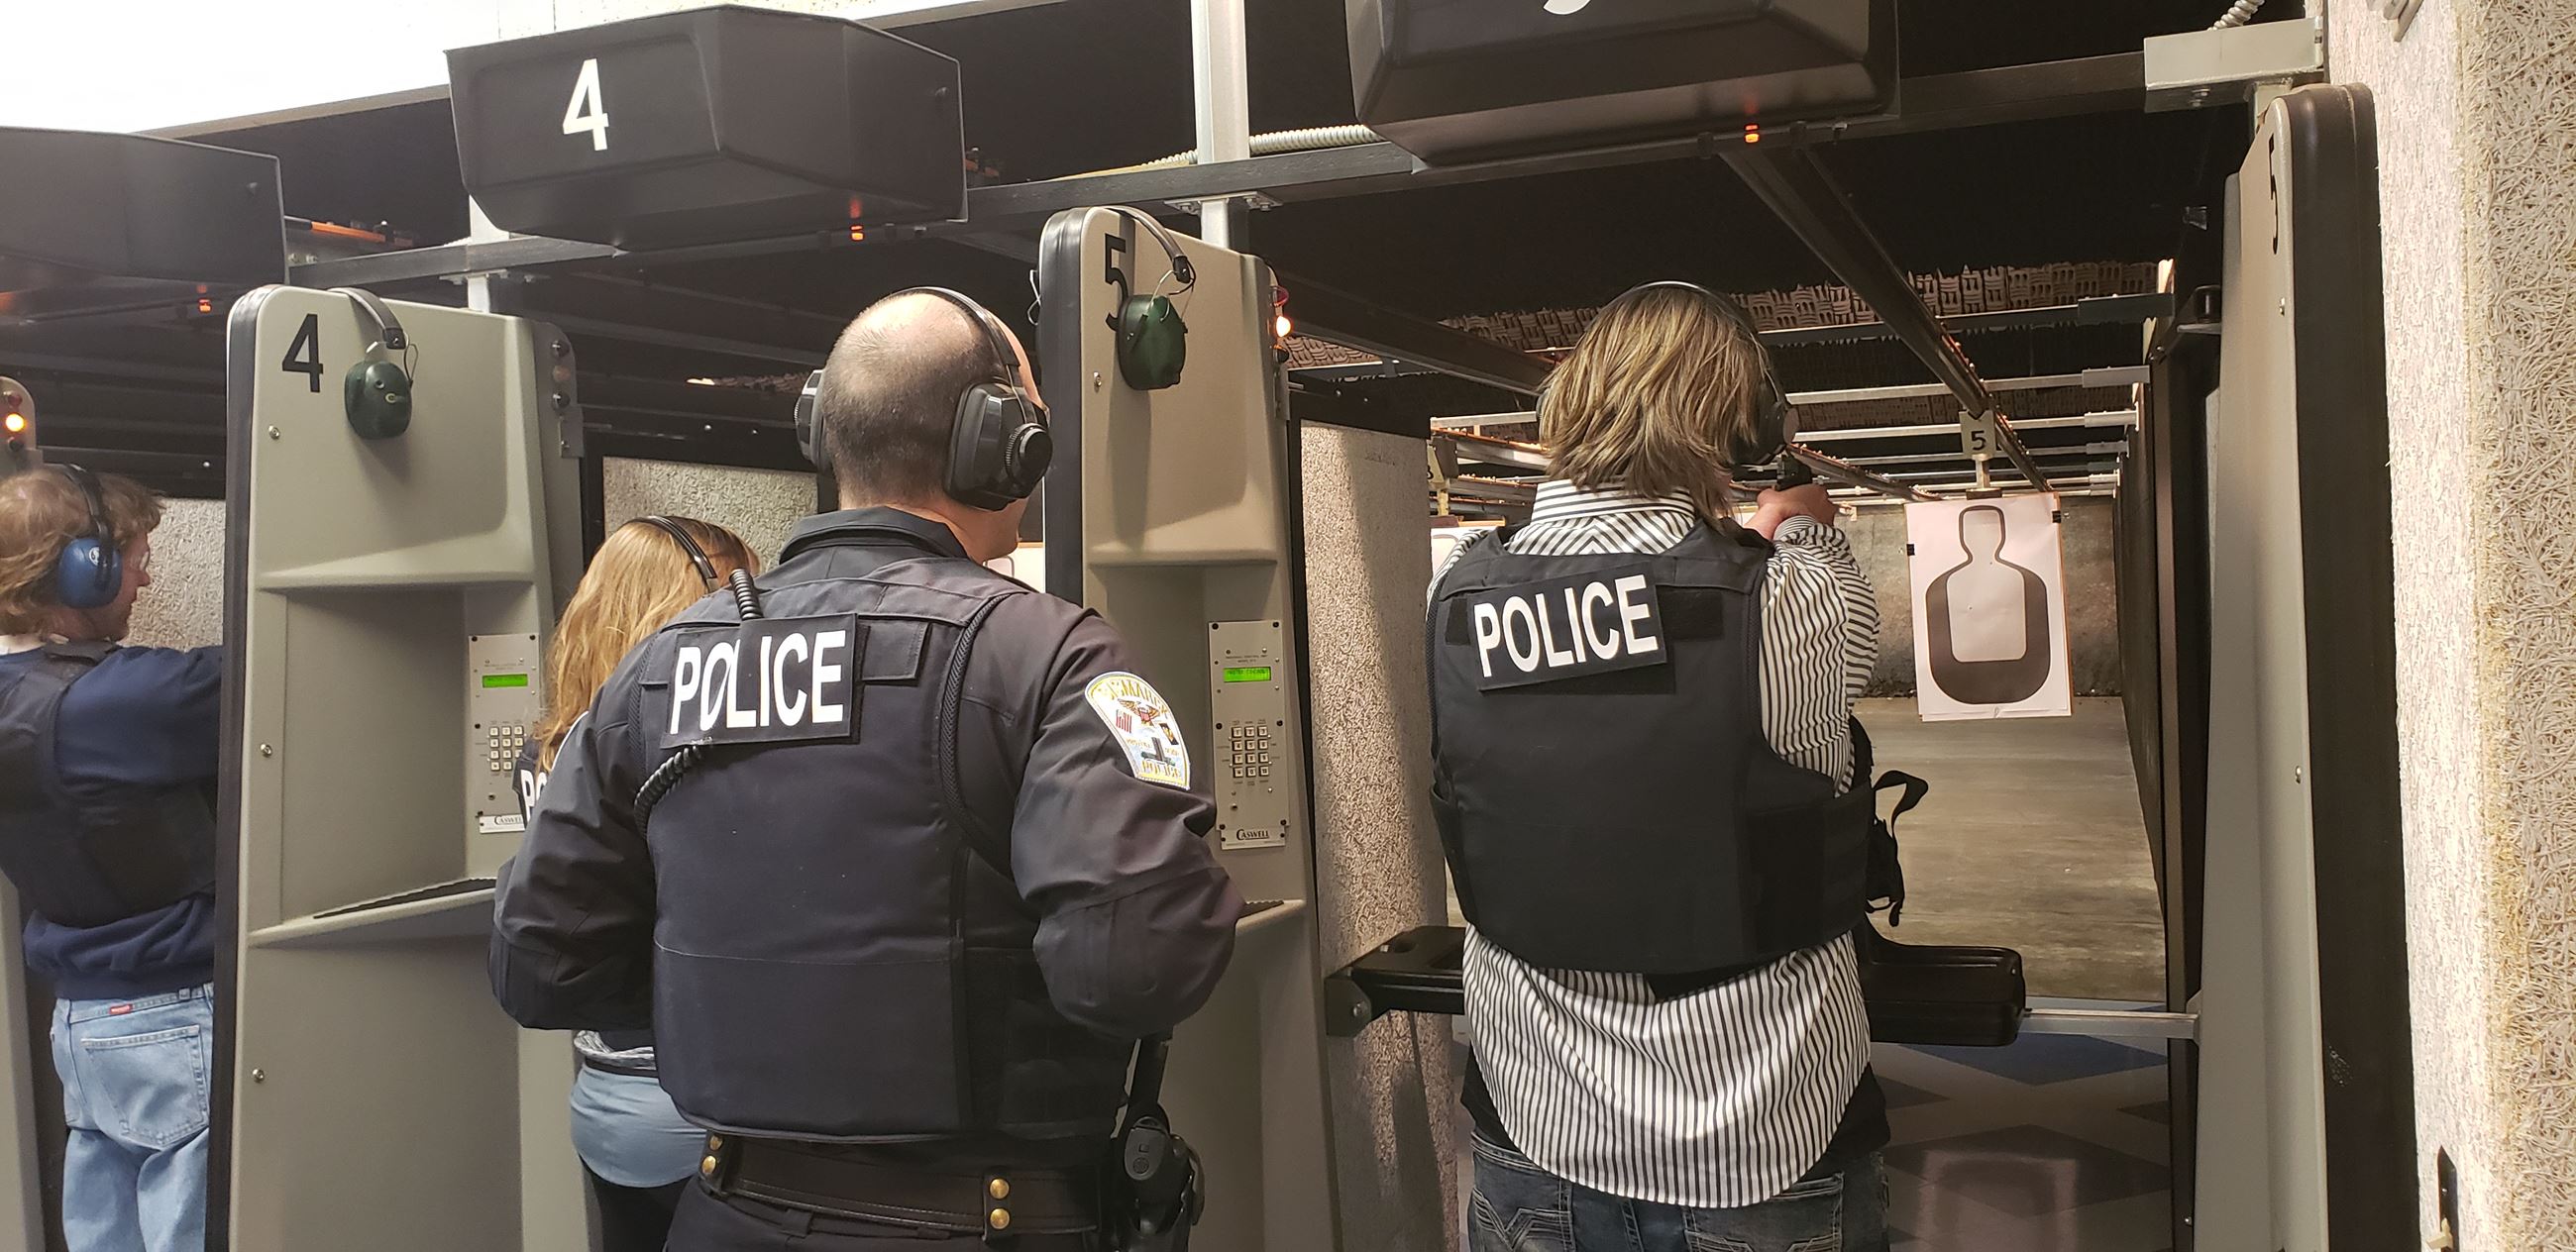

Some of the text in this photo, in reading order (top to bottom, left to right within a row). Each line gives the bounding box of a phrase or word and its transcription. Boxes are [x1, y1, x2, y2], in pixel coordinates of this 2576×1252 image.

[562, 58, 609, 151] 4
[1104, 233, 1129, 332] 5
[281, 313, 324, 394] 4
[1970, 430, 1986, 451] 5
[1473, 574, 1659, 678] POLICE
[670, 630, 846, 735] POLICE
[1235, 828, 1269, 841] CASWELL
